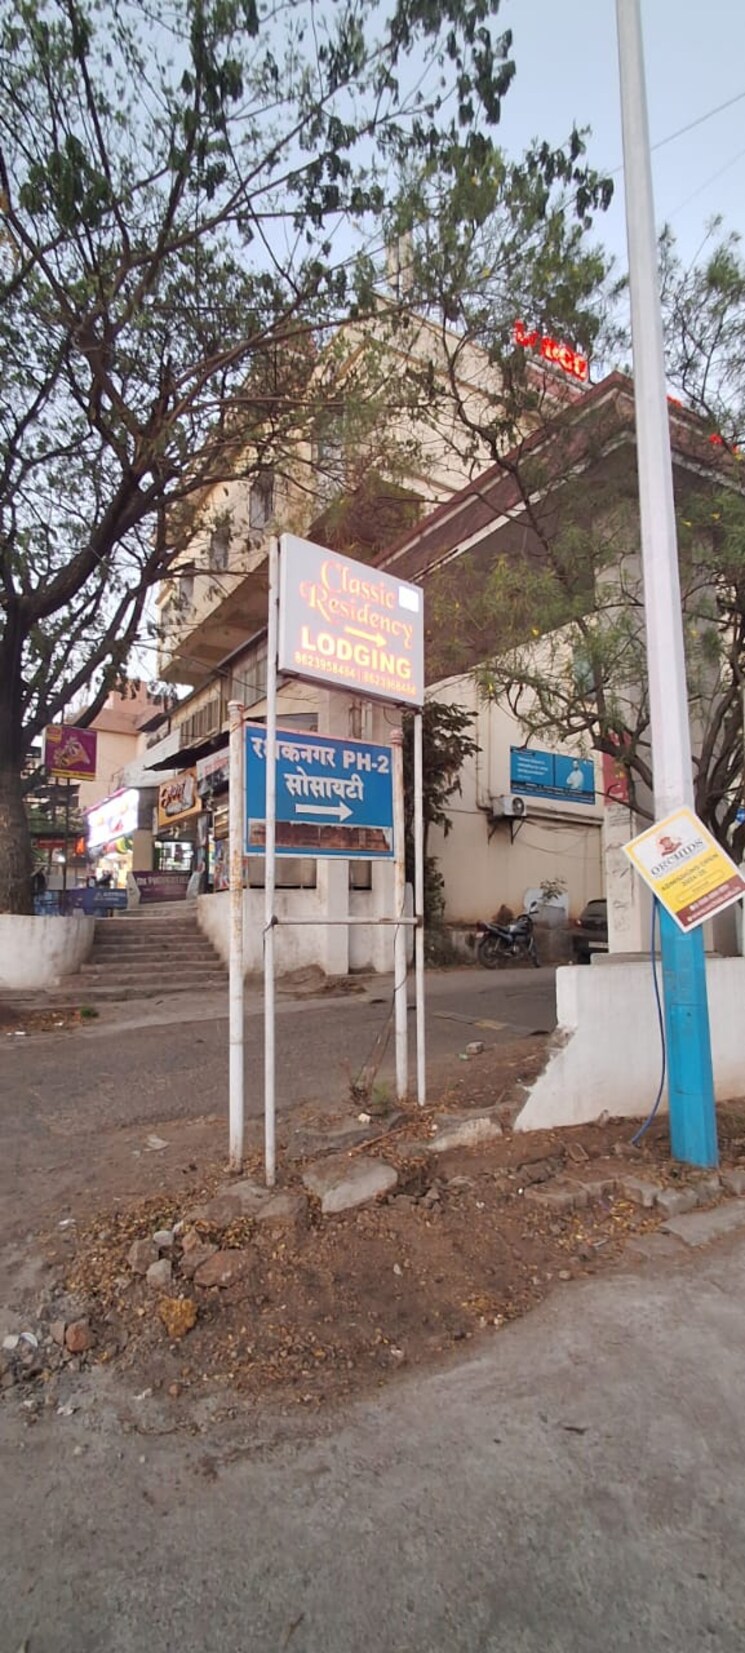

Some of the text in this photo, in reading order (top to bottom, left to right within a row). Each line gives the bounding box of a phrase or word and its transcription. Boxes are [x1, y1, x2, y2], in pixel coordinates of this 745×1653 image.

[321, 560, 395, 609] Classic
[299, 580, 413, 649] Residency
[302, 626, 411, 679] LODGING
[251, 737, 336, 767] रकनगर
[342, 749, 390, 774] PH-2
[284, 766, 364, 800] सोसायटी
[651, 840, 703, 876] ORCHIDS
